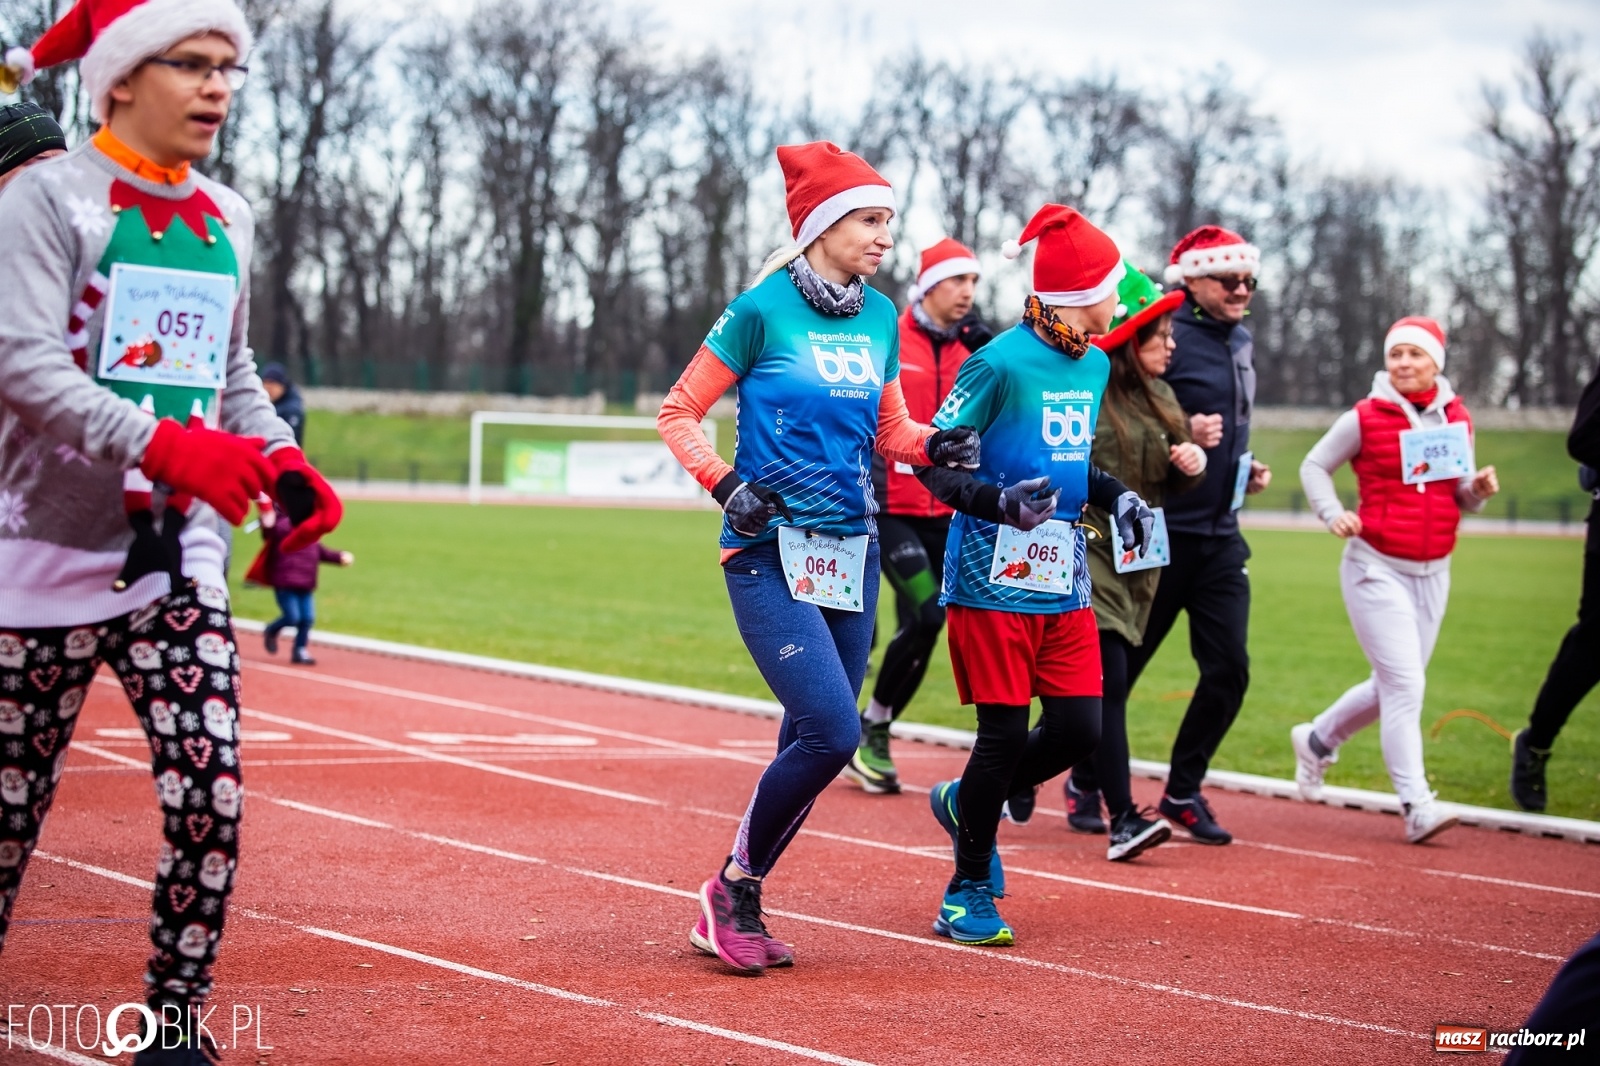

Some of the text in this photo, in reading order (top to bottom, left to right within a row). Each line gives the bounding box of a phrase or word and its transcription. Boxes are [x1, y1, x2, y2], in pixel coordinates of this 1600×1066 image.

[157, 310, 205, 339] 057
[811, 345, 881, 387] bbl
[830, 389, 870, 400] RACIBÓRZ
[1042, 405, 1094, 447] bbl
[1051, 451, 1085, 462] RACIBÓRZ
[1027, 542, 1059, 563] 065
[806, 556, 837, 577] 064
